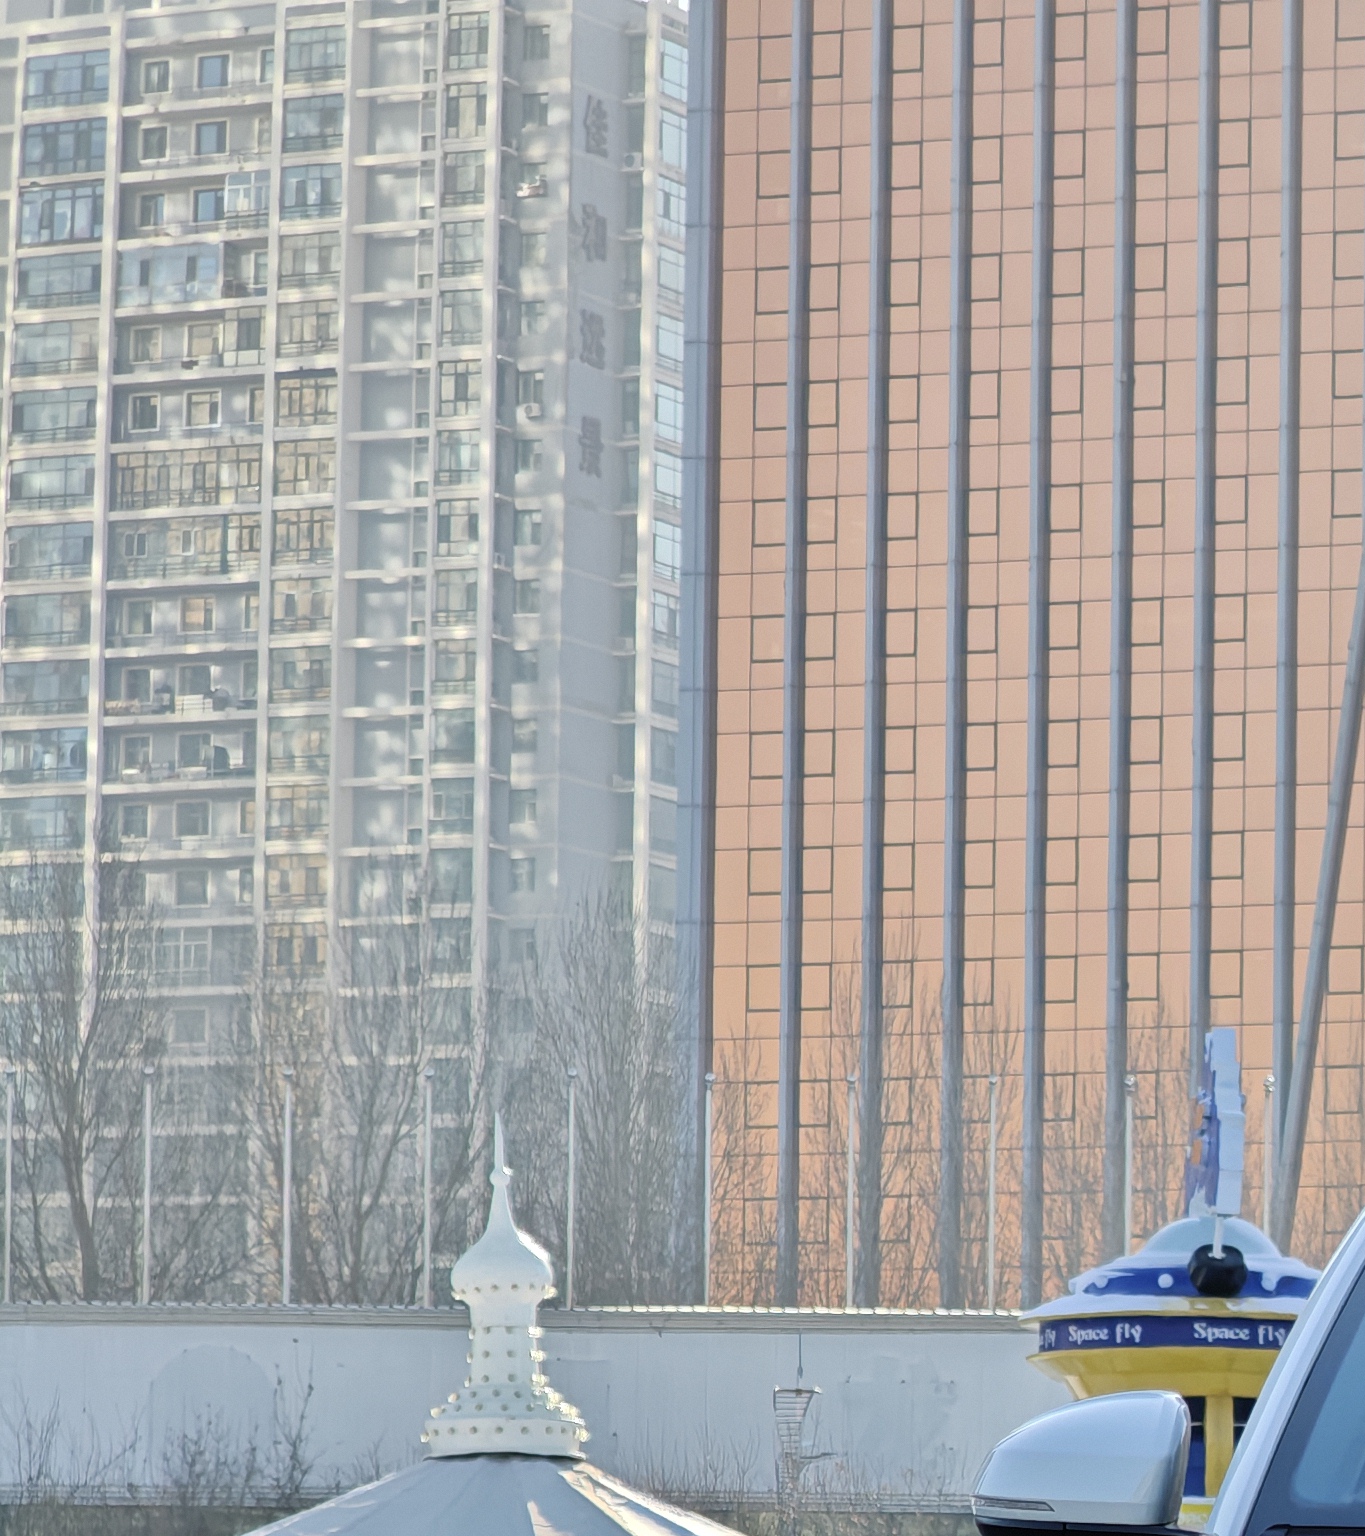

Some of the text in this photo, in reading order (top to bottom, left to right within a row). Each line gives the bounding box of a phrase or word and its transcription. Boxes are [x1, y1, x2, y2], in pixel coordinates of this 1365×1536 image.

[1068, 1324, 1110, 1345] Space
[1115, 1322, 1143, 1343] fly
[1193, 1322, 1287, 1346] Space fly
